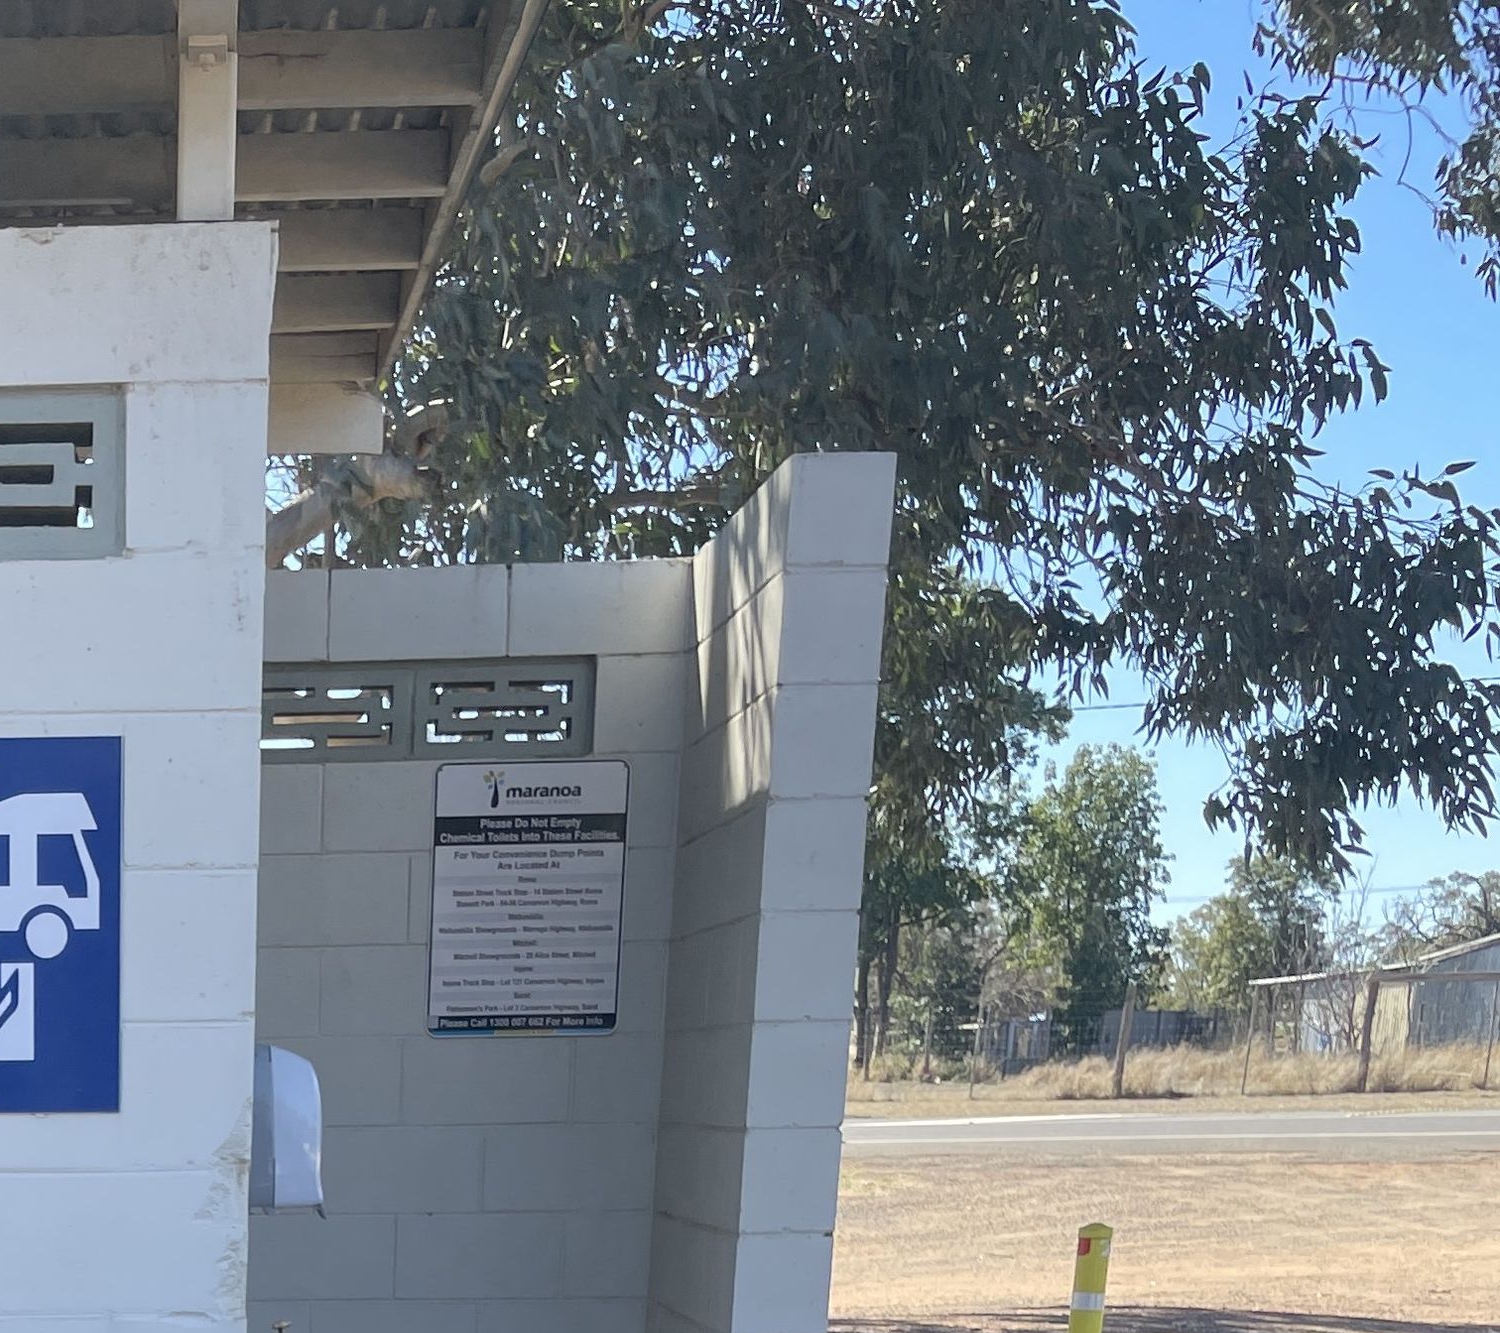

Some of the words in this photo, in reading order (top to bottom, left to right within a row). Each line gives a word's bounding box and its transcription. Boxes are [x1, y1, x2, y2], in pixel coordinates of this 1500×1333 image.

[506, 785, 582, 798] maranoa
[480, 818, 513, 829] Please
[514, 818, 528, 828] Do
[530, 818, 548, 828] Not
[550, 817, 582, 829] Empty
[440, 832, 485, 843] Chemical
[488, 832, 520, 842] Toilets
[521, 831, 541, 841] Into
[543, 830, 572, 841] These
[454, 851, 469, 860] For
[471, 850, 490, 860] Your
[492, 850, 547, 859] Convenience
[549, 849, 575, 859] Dump
[577, 848, 604, 858] Points
[497, 862, 512, 870] Are
[514, 861, 549, 870] Located
[440, 1018, 468, 1028] Please
[470, 1018, 487, 1027] Call
[546, 1016, 560, 1026] For
[562, 1016, 584, 1026] More
[586, 1015, 603, 1026] Info
